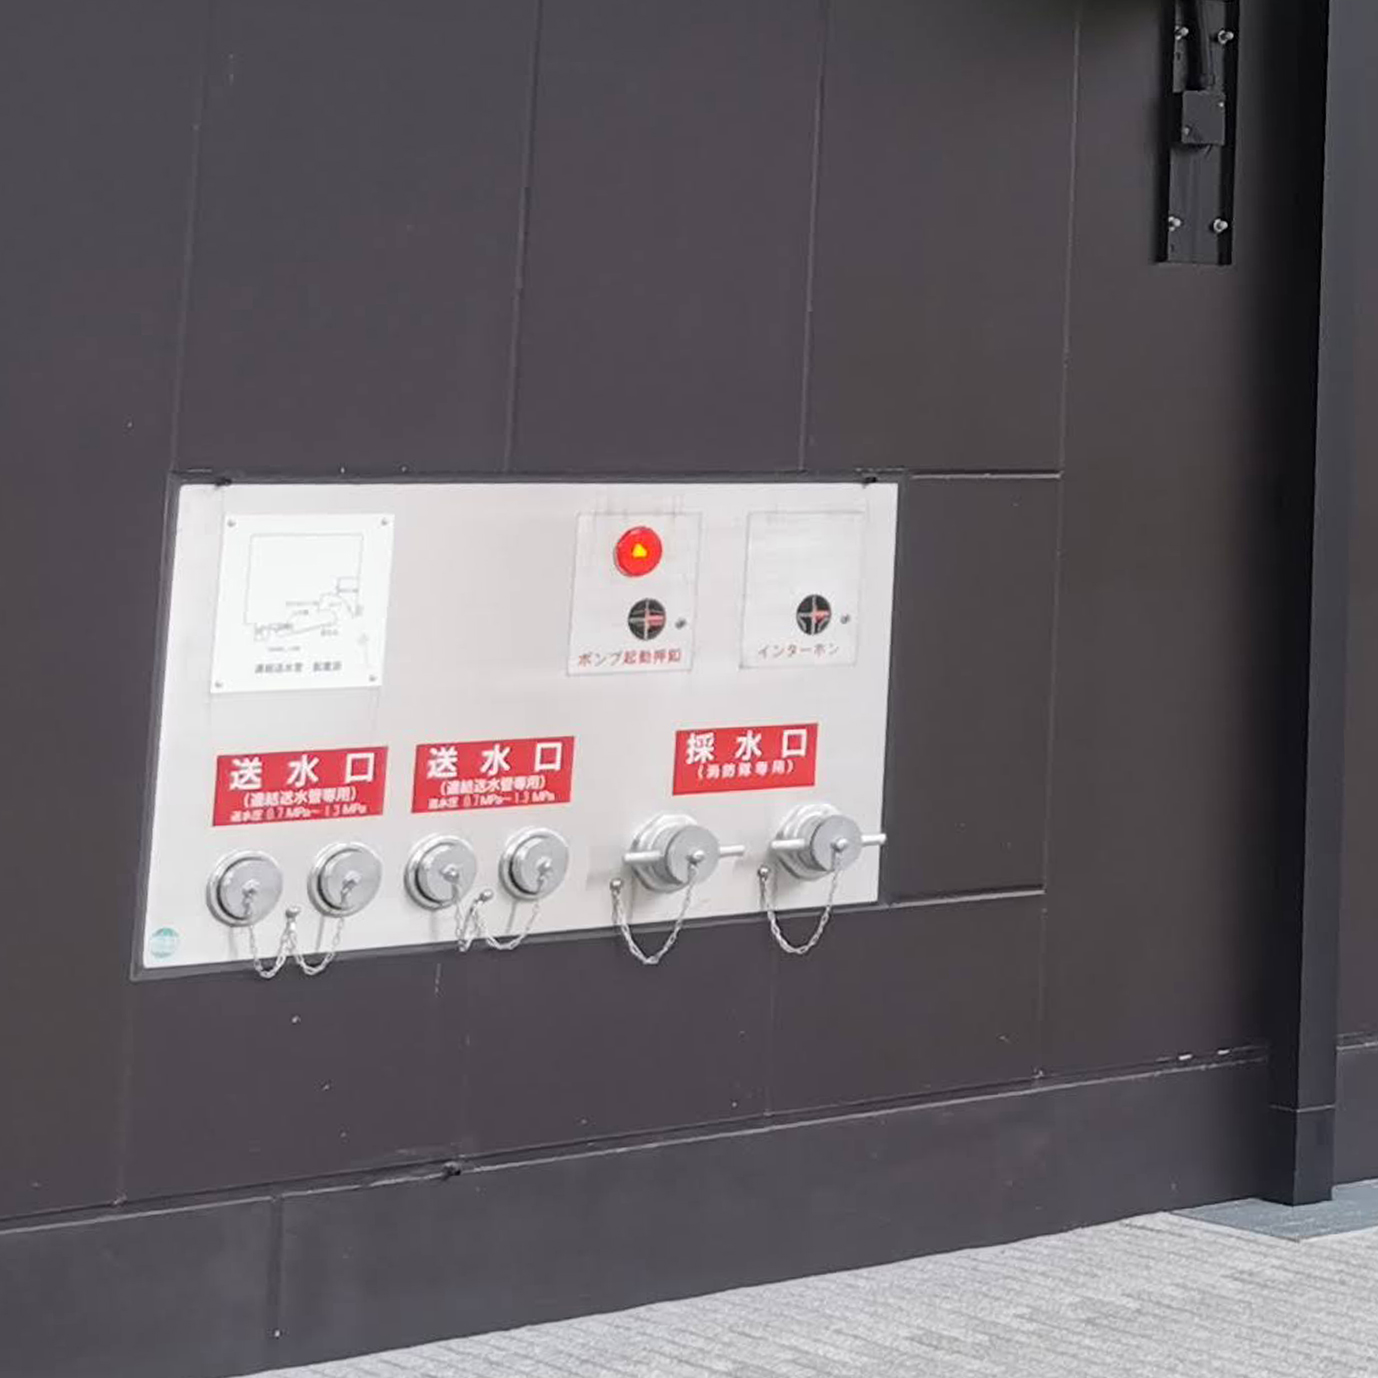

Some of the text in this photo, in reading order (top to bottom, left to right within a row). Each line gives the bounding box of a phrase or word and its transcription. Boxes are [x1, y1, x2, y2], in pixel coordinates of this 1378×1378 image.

[427, 742, 563, 780] 送水口
[685, 728, 807, 764] 採水口
[229, 752, 374, 790] 送水口
